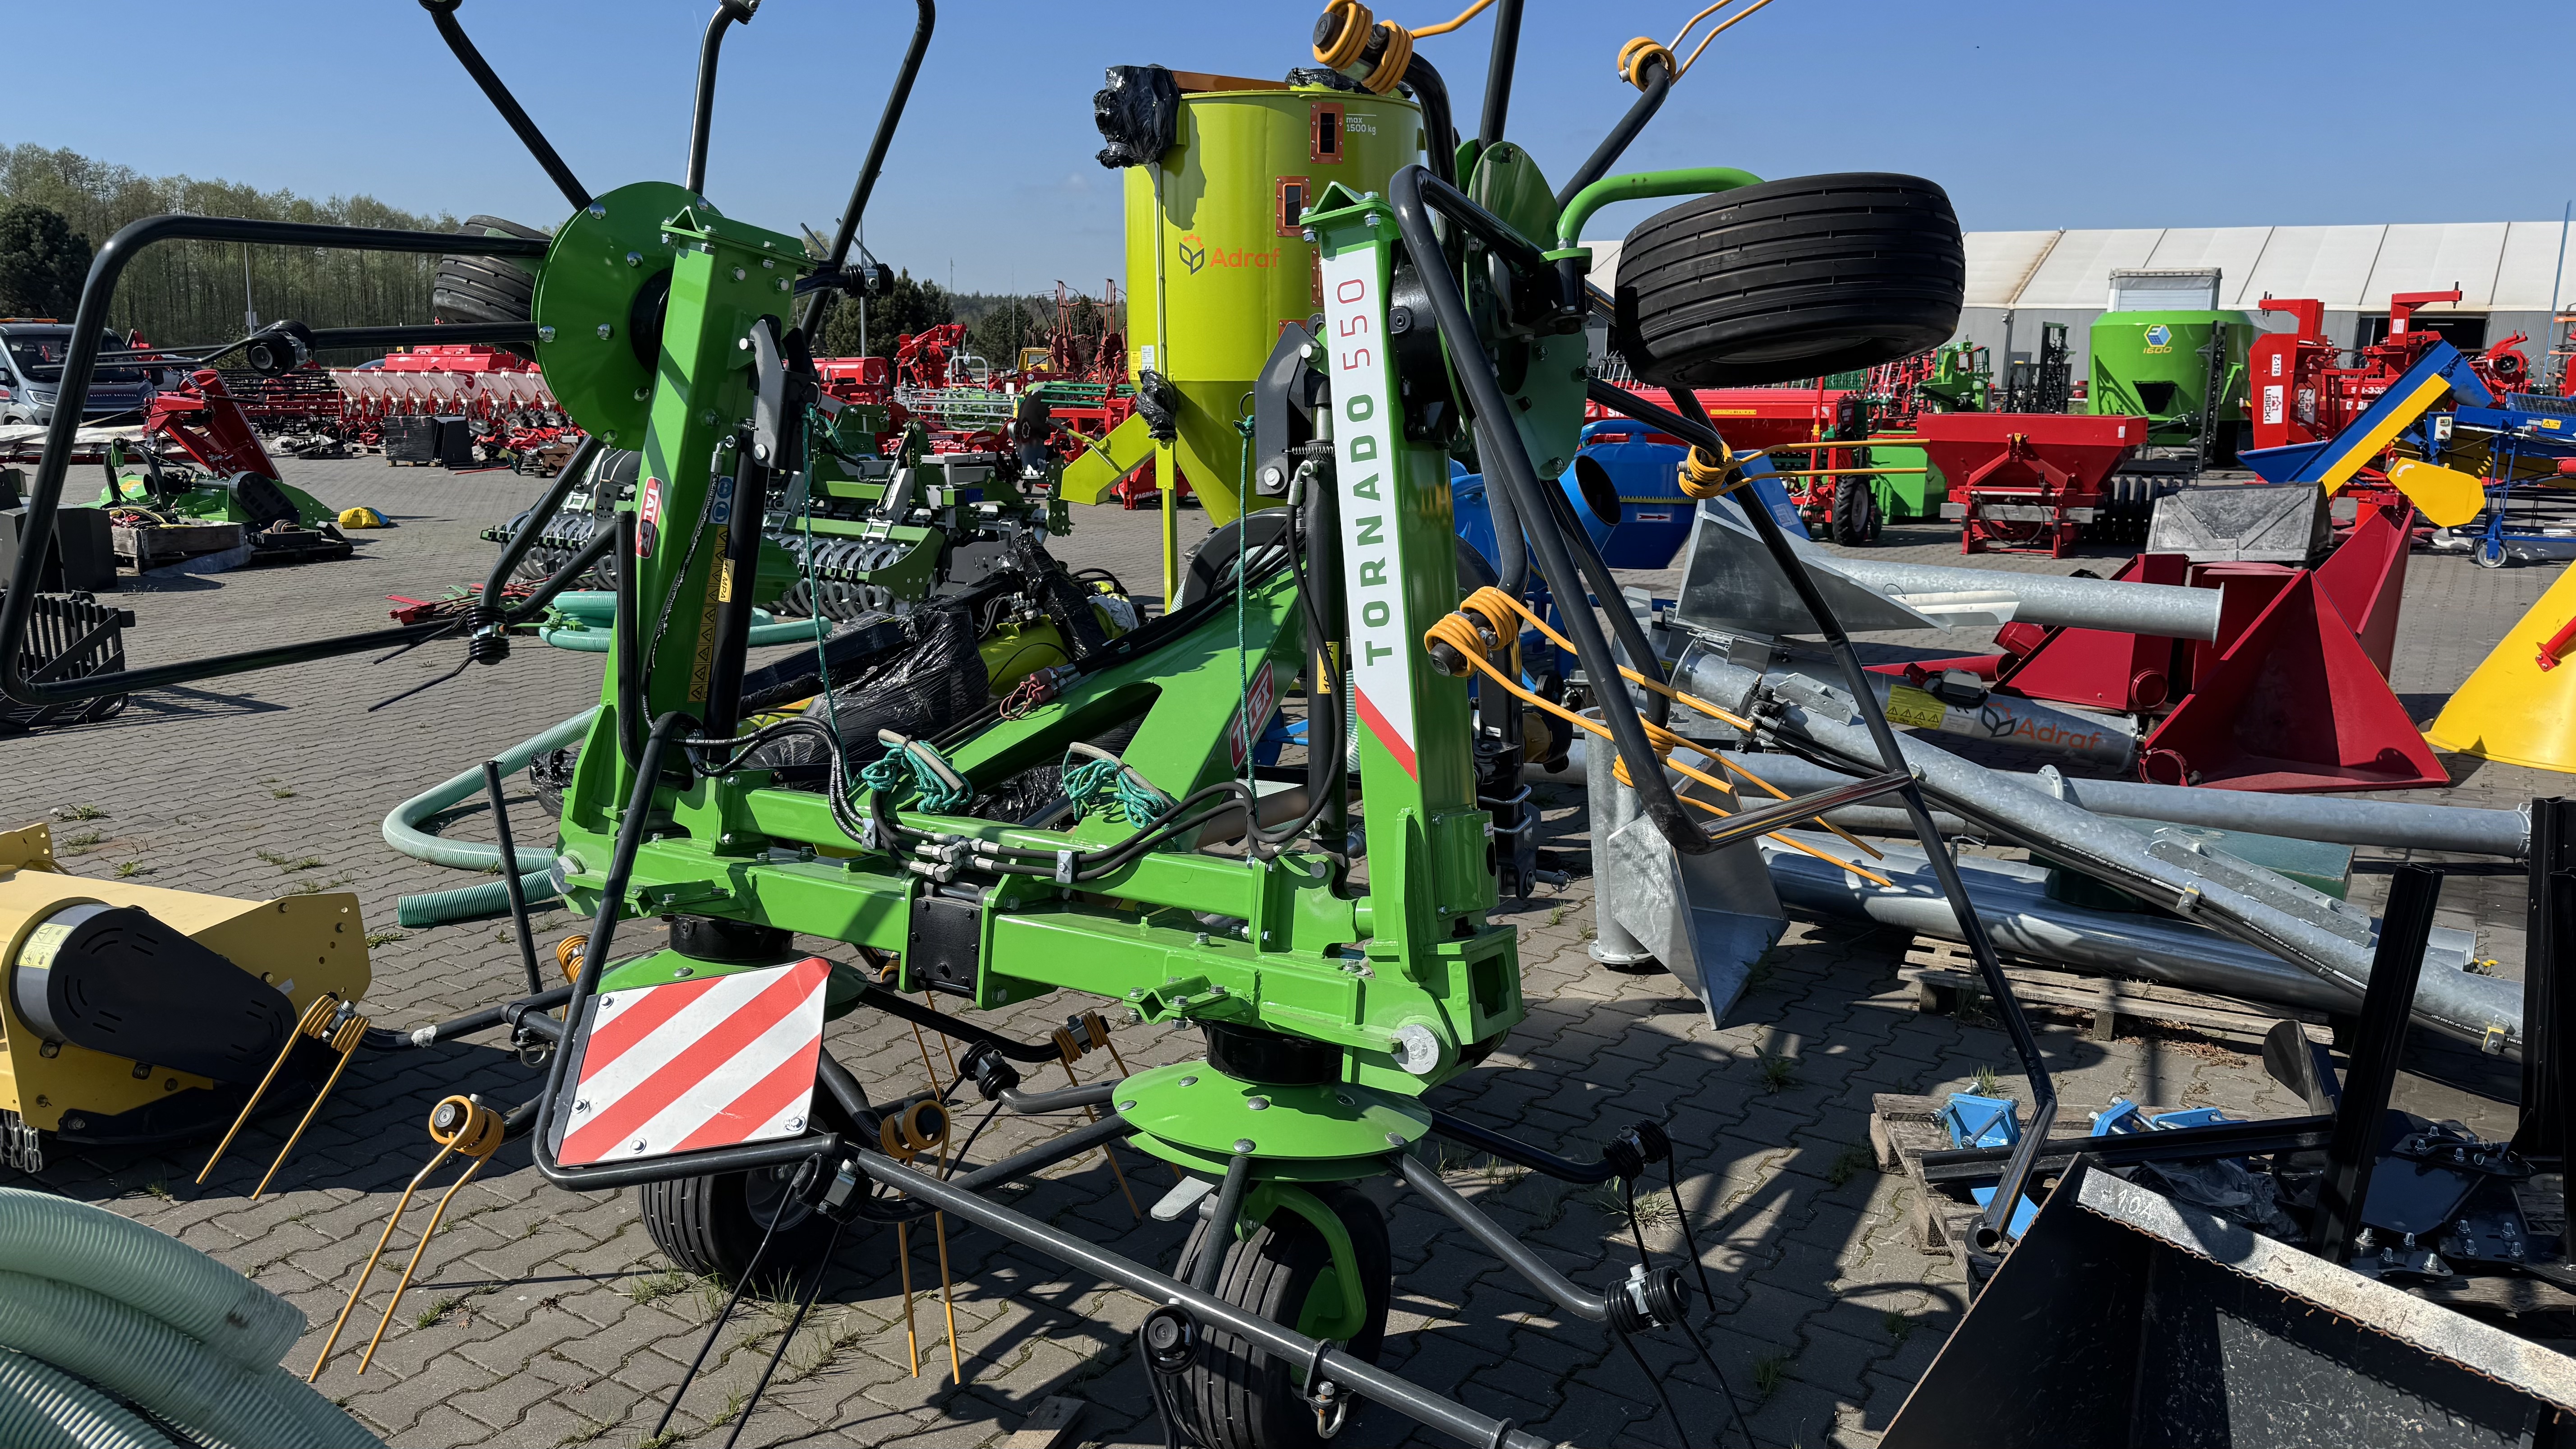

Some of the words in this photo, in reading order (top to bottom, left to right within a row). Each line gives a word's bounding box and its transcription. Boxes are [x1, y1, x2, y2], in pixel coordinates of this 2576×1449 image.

[1346, 124, 1366, 132] 1500
[1367, 125, 1376, 135] kg
[1210, 247, 1281, 268] Adraf
[1337, 278, 1371, 371] 550
[640, 484, 661, 553] TALEX
[1346, 393, 1394, 667] TORNADO
[1233, 670, 1270, 753] TLEX
[2014, 719, 2102, 751] Adraf
